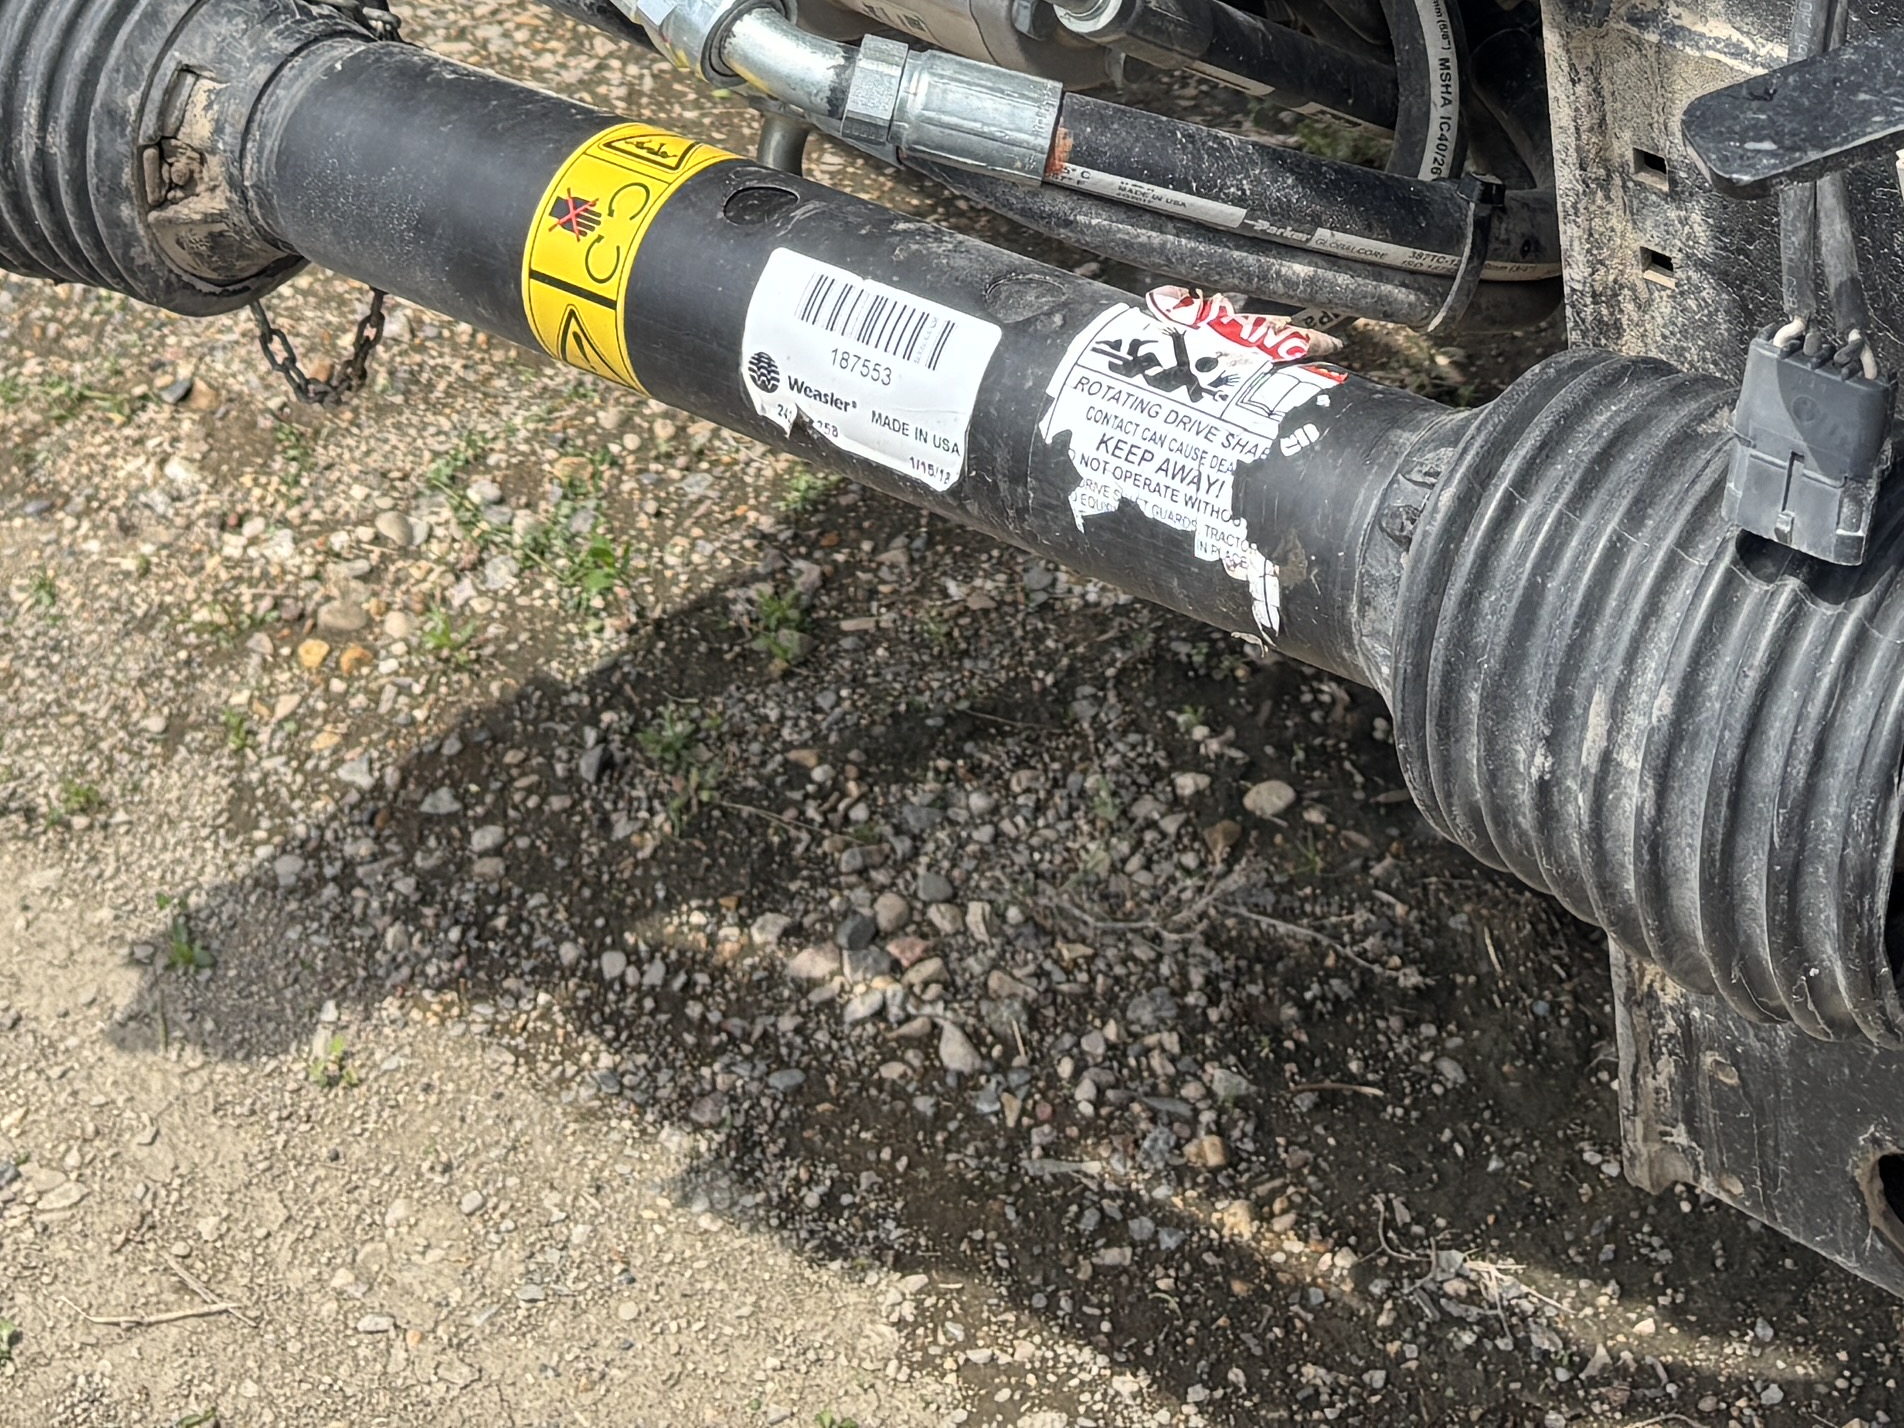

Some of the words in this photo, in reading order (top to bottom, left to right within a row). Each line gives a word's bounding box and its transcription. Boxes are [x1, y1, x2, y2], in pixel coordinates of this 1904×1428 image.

[1438, 56, 1453, 110] MSHA
[831, 347, 893, 387] 187553
[871, 410, 910, 438] MADE
[914, 426, 929, 445] IN
[933, 437, 962, 458] USA
[1073, 375, 1163, 419] ROTATING
[1163, 409, 1218, 444] DRIVE
[1085, 405, 1140, 438] CONTACT
[1142, 427, 1166, 449] CAN
[1168, 438, 1208, 464] CAUSE
[1079, 452, 1113, 480] NOT
[1112, 466, 1180, 504] OPERATE
[1096, 432, 1155, 466] KEEP
[1157, 457, 1226, 499] AWAY!
